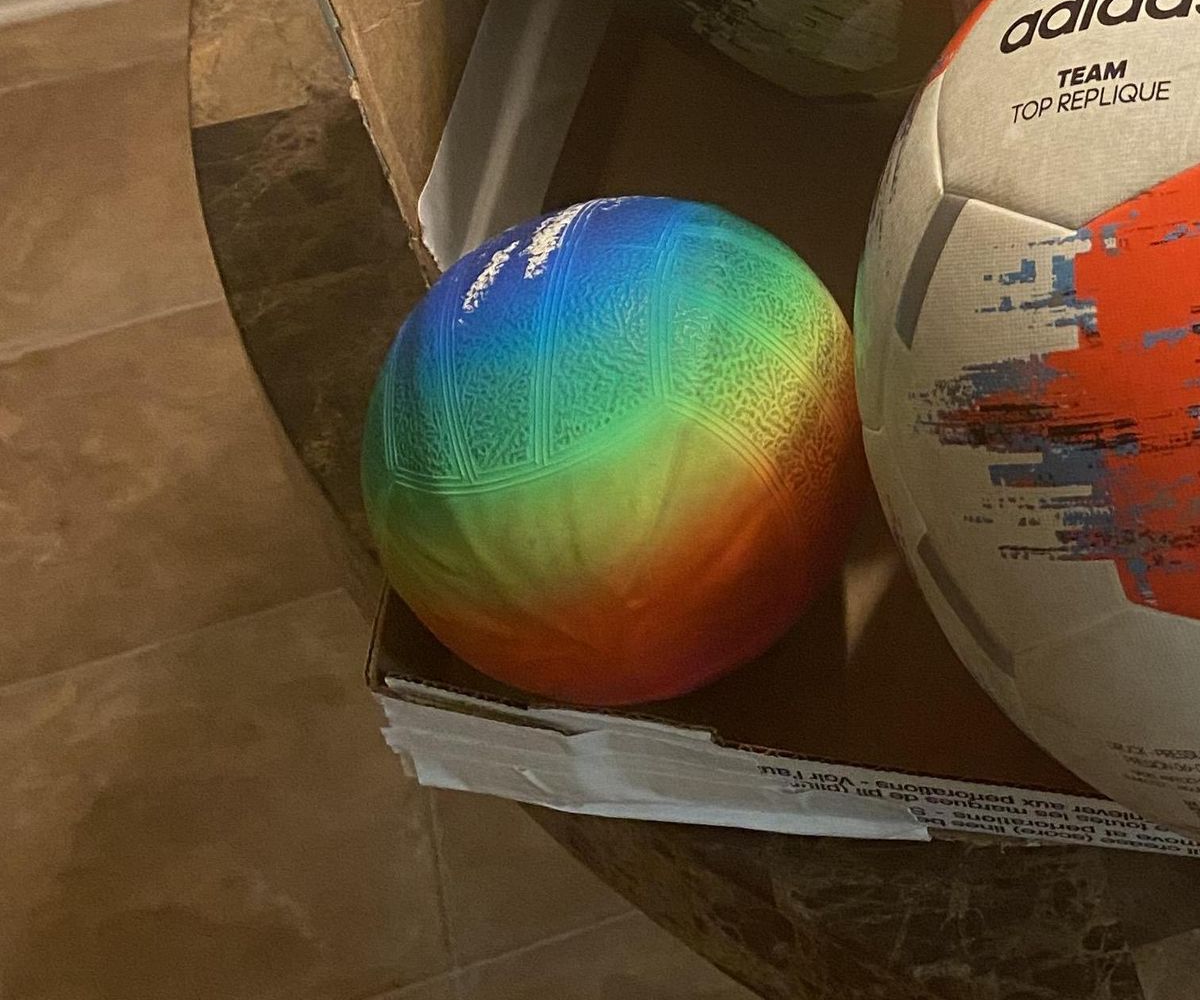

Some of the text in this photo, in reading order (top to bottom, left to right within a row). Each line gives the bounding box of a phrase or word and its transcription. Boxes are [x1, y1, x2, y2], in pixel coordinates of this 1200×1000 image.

[1057, 59, 1128, 88] TEAM
[1011, 80, 1172, 124] TOP REPLIQUE
[809, 772, 856, 787] Voir
[875, 780, 1016, 804] perforations
[889, 791, 919, 802] de
[925, 796, 1027, 815] marques
[1023, 799, 1065, 810] aux
[953, 810, 1096, 833] perforations
[1034, 809, 1068, 821] les
[1076, 814, 1148, 831] toutes
[951, 819, 1005, 834] lines
